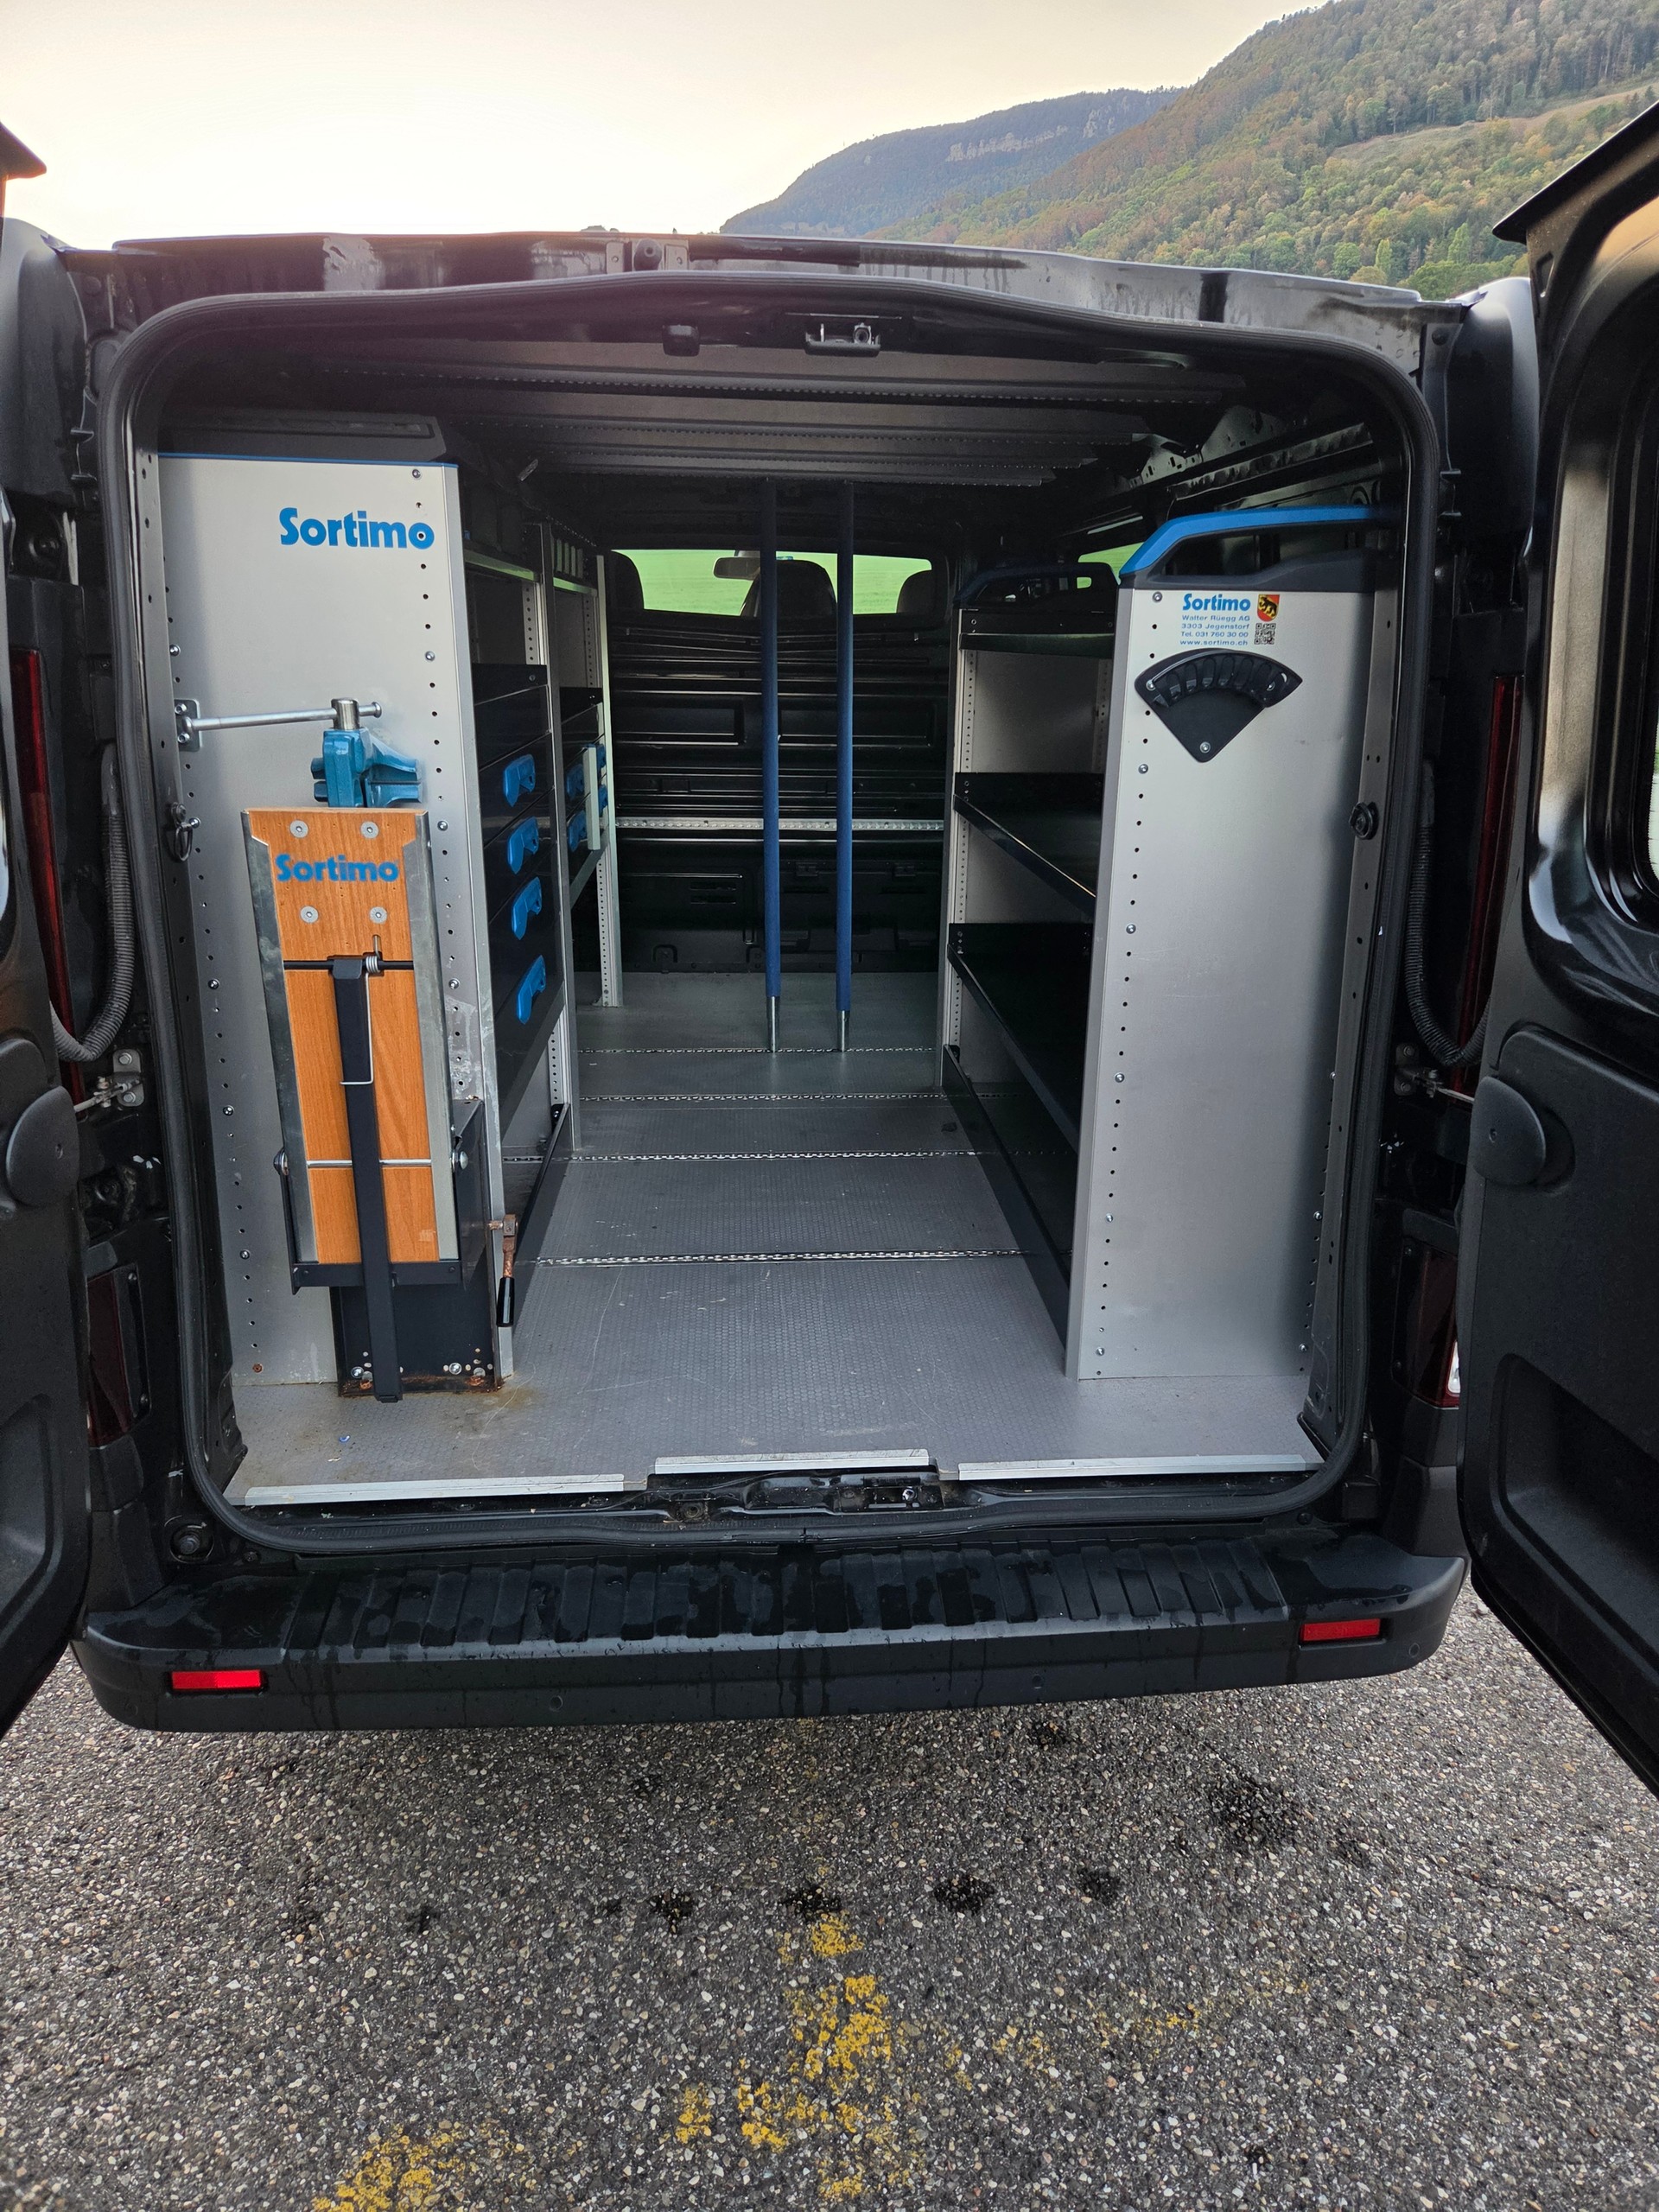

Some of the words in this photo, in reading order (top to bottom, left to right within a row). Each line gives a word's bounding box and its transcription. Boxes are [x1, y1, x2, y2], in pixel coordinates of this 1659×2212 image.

[279, 507, 435, 550] Sortimo
[1182, 593, 1251, 611] Sortimo
[275, 853, 400, 882] Sortimo
